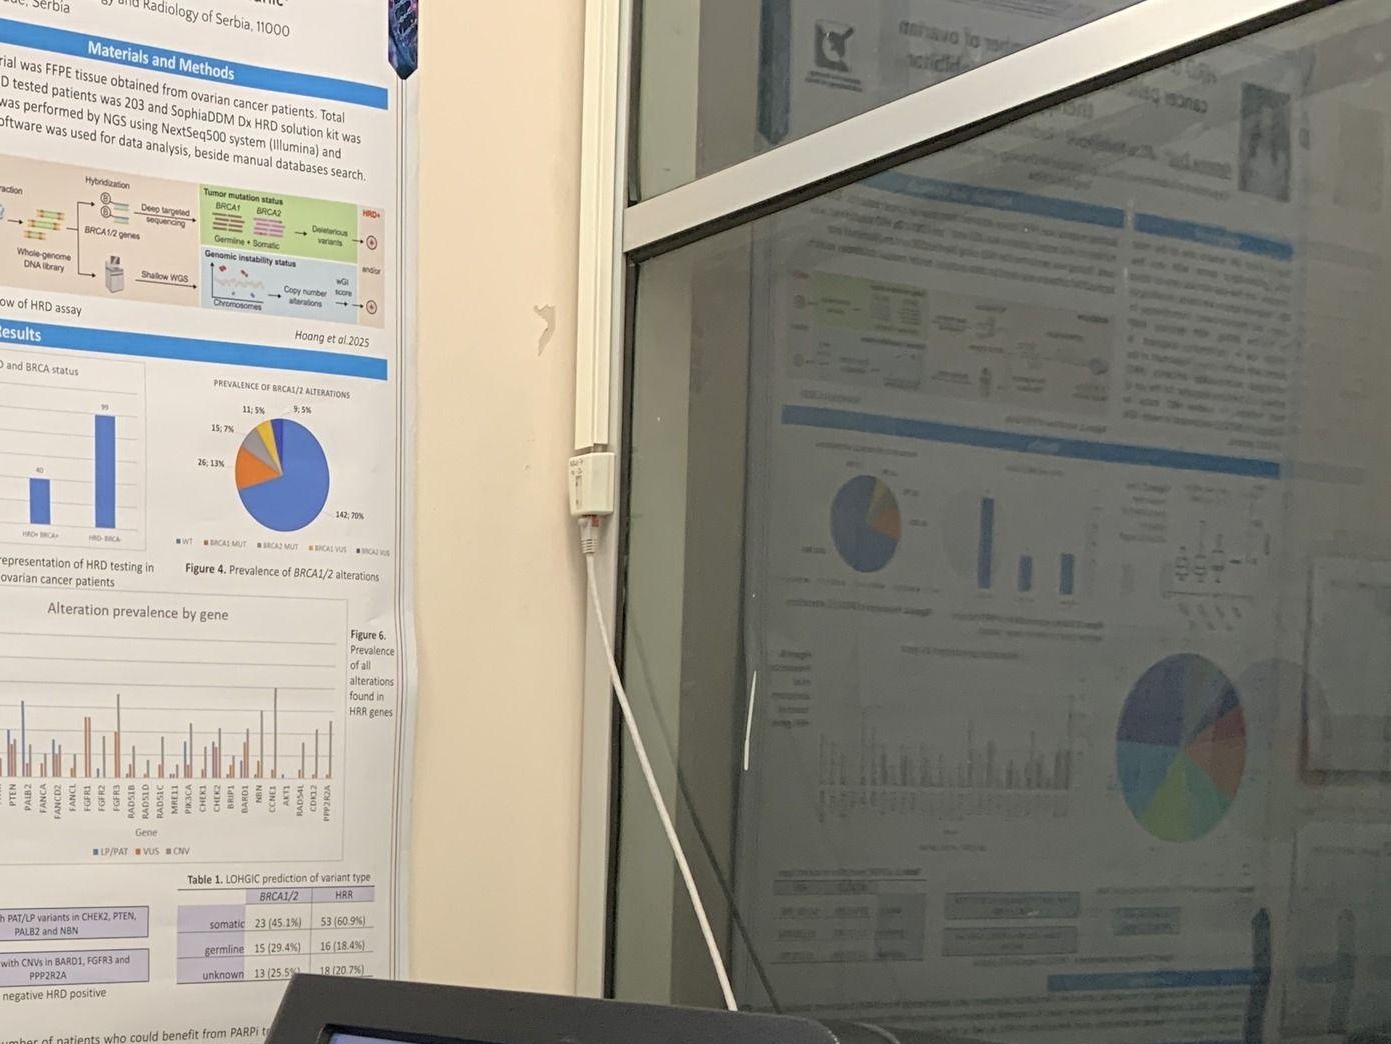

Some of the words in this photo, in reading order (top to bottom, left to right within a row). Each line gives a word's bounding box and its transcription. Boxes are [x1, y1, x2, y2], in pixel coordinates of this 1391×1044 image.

[201, 9, 213, 22] of
[215, 12, 253, 32] Serbia,
[256, 20, 290, 37] 11000
[88, 40, 148, 64] Materials
[151, 55, 176, 69] and
[179, 57, 234, 80] Methods
[20, 60, 42, 73] was
[45, 62, 72, 78] FFPE
[75, 68, 107, 85] tissue
[110, 75, 159, 94] obtained
[162, 82, 187, 99] from
[190, 91, 230, 106] ovarian
[233, 98, 268, 111] cancer
[271, 104, 317, 119] patients.
[319, 109, 344, 123] Total
[17, 298, 28, 309] of
[30, 299, 52, 311] HRD
[55, 304, 82, 317] assay
[336, 511, 350, 519] 142;
[351, 511, 364, 520] 70%
[185, 562, 215, 575] Figure
[217, 564, 226, 574] 4.
[229, 564, 279, 576] Prevalence
[281, 566, 292, 577] of
[293, 567, 333, 580] BRCA1/2
[336, 570, 379, 582] alterations
[47, 601, 109, 616] Alteration
[113, 605, 178, 619] prevalence
[182, 606, 196, 622] by
[199, 611, 228, 622] gene
[135, 828, 157, 837] Gene
[187, 874, 212, 885] Table
[215, 874, 223, 884] 1.
[226, 874, 260, 884] LOHGIC
[262, 873, 307, 885] prediction
[309, 872, 319, 882] of
[320, 872, 350, 882] variant
[352, 873, 370, 883] type
[259, 890, 298, 902] BRCA1/2
[335, 889, 353, 899] HRR
[209, 919, 245, 929] somatic
[255, 918, 266, 928] 23
[268, 917, 301, 929] (45.1%)
[321, 916, 332, 926] 53
[333, 915, 365, 928] (60.9%)
